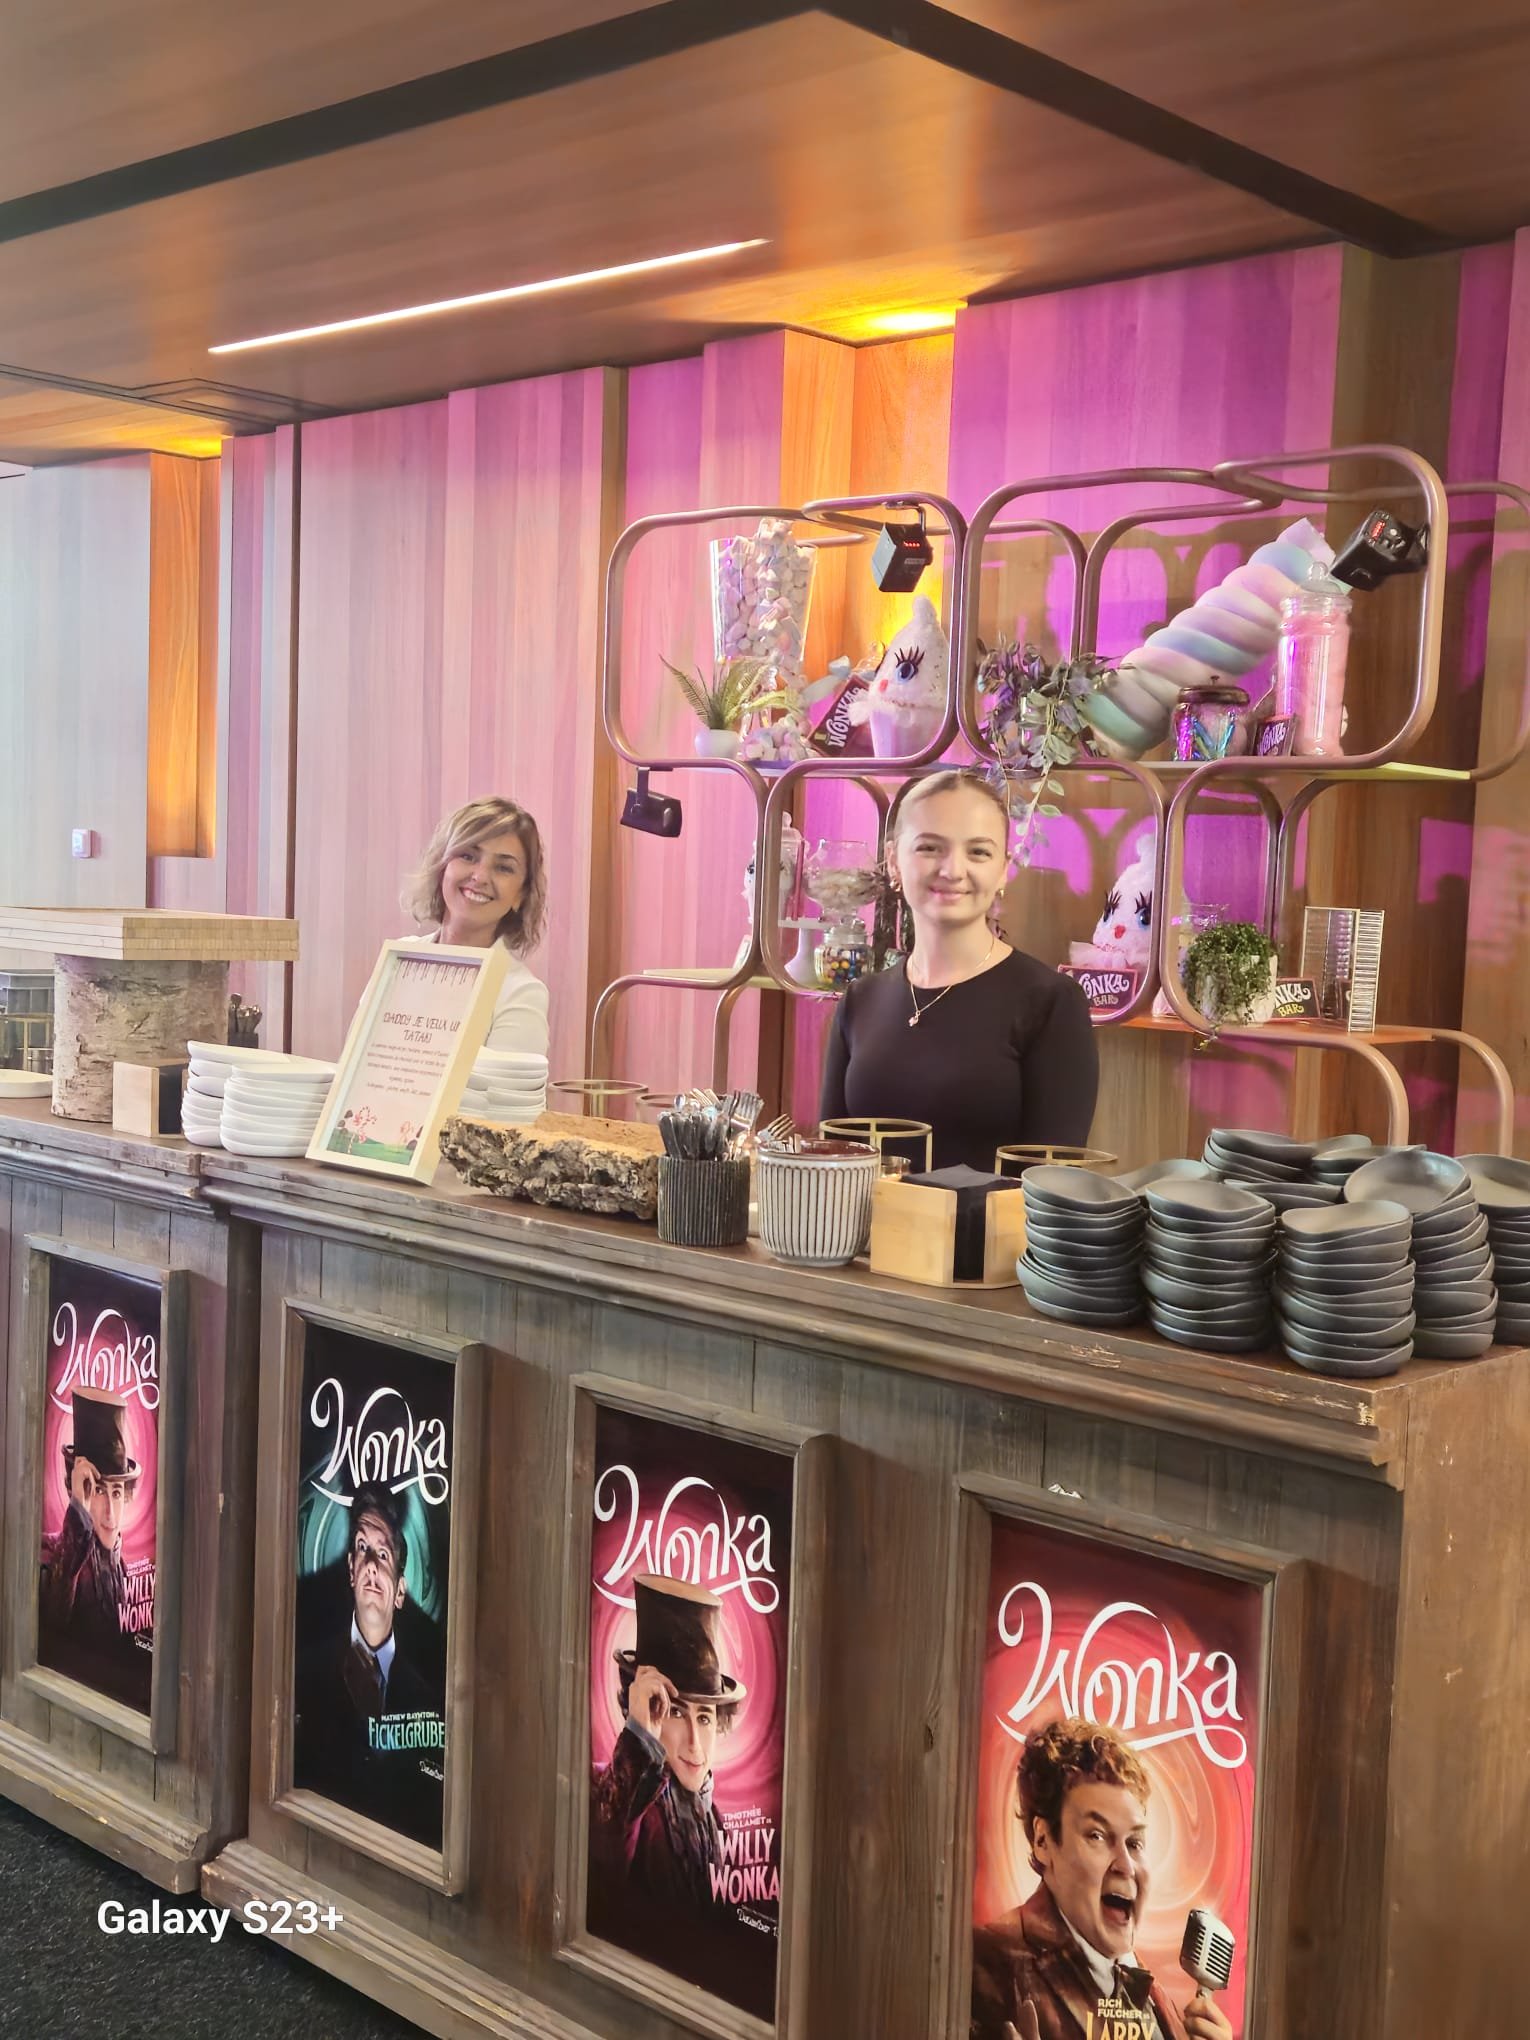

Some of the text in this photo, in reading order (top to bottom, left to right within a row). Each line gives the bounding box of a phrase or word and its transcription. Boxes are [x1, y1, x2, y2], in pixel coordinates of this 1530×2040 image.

[1078, 973, 1130, 1000] ONKA
[1093, 994, 1119, 1007] BAR
[1274, 983, 1312, 1009] NKA
[383, 1011, 411, 1026] DADDY
[412, 1016, 424, 1028] JE
[426, 1016, 447, 1031] VEUX
[1277, 1003, 1305, 1017] BAR
[50, 1302, 160, 1415] Wonka
[310, 1377, 449, 1507] Wonka
[593, 1464, 780, 1614] Wonka
[123, 1572, 156, 1606] WILLY
[118, 1602, 154, 1633] WONK
[995, 1581, 1247, 1769] Wonka
[368, 1716, 445, 1750] FICKELGRUBE
[723, 1816, 766, 1830] CHALAMET
[718, 1828, 776, 1867] WILLY
[709, 1862, 780, 1904] WONKA
[1097, 1998, 1122, 2009] RICH
[1097, 2008, 1143, 2019] FULCHER
